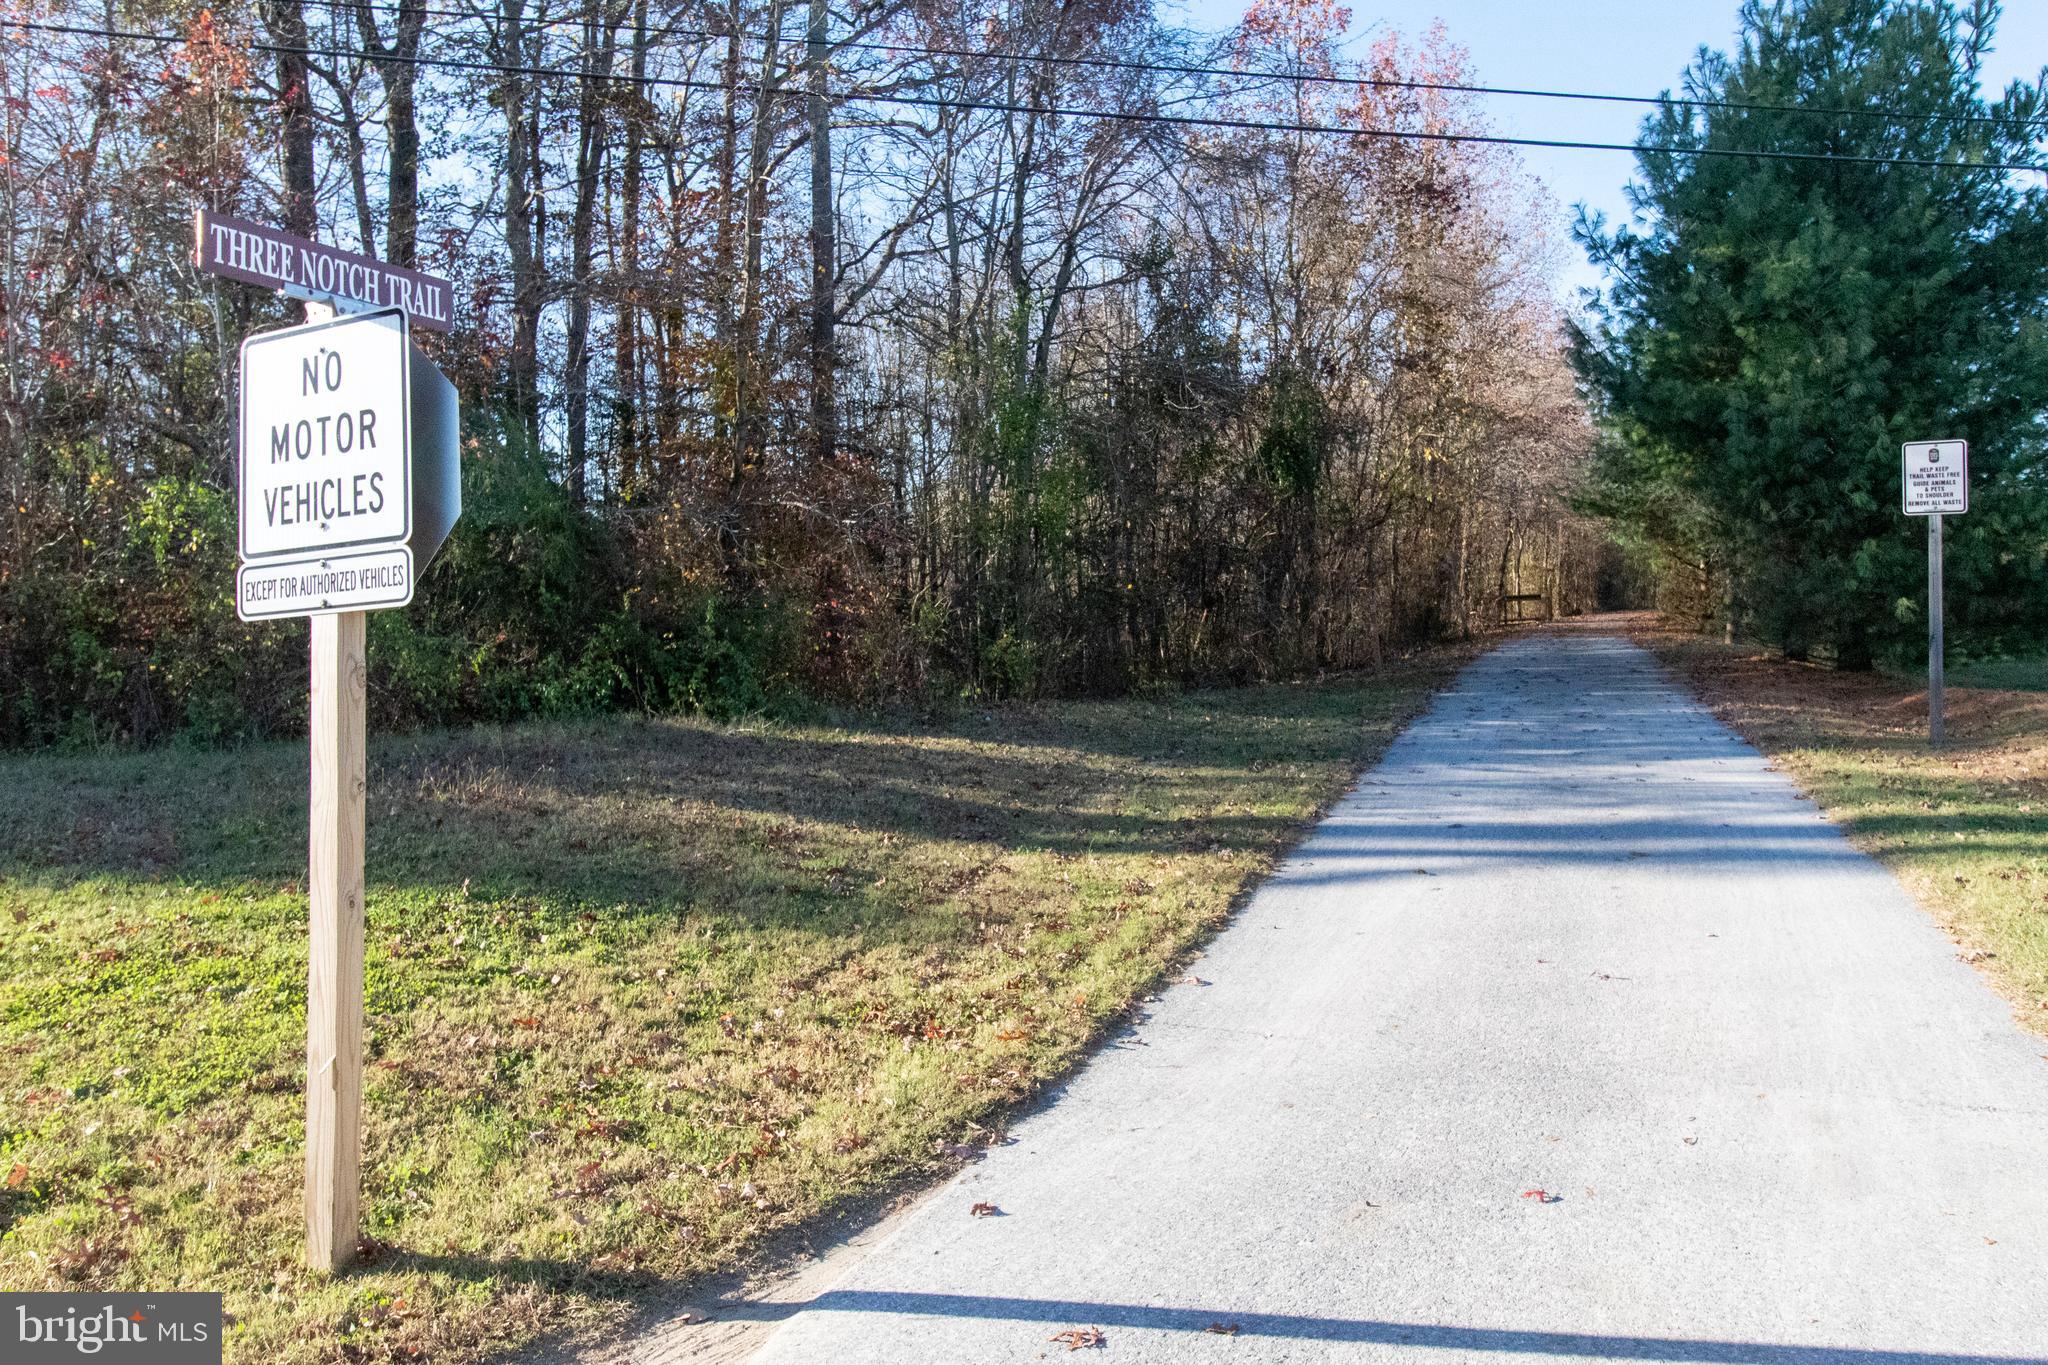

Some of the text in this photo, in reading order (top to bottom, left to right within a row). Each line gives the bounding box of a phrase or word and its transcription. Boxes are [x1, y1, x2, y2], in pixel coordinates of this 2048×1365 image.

[211, 223, 446, 322] THREE NOTCH TRAIL
[302, 350, 342, 396] NO
[271, 408, 376, 464] MOTOR
[264, 472, 384, 527] VEHICLES
[246, 565, 404, 602] EXCEPT FOR AUTHORIZED VEHICLES
